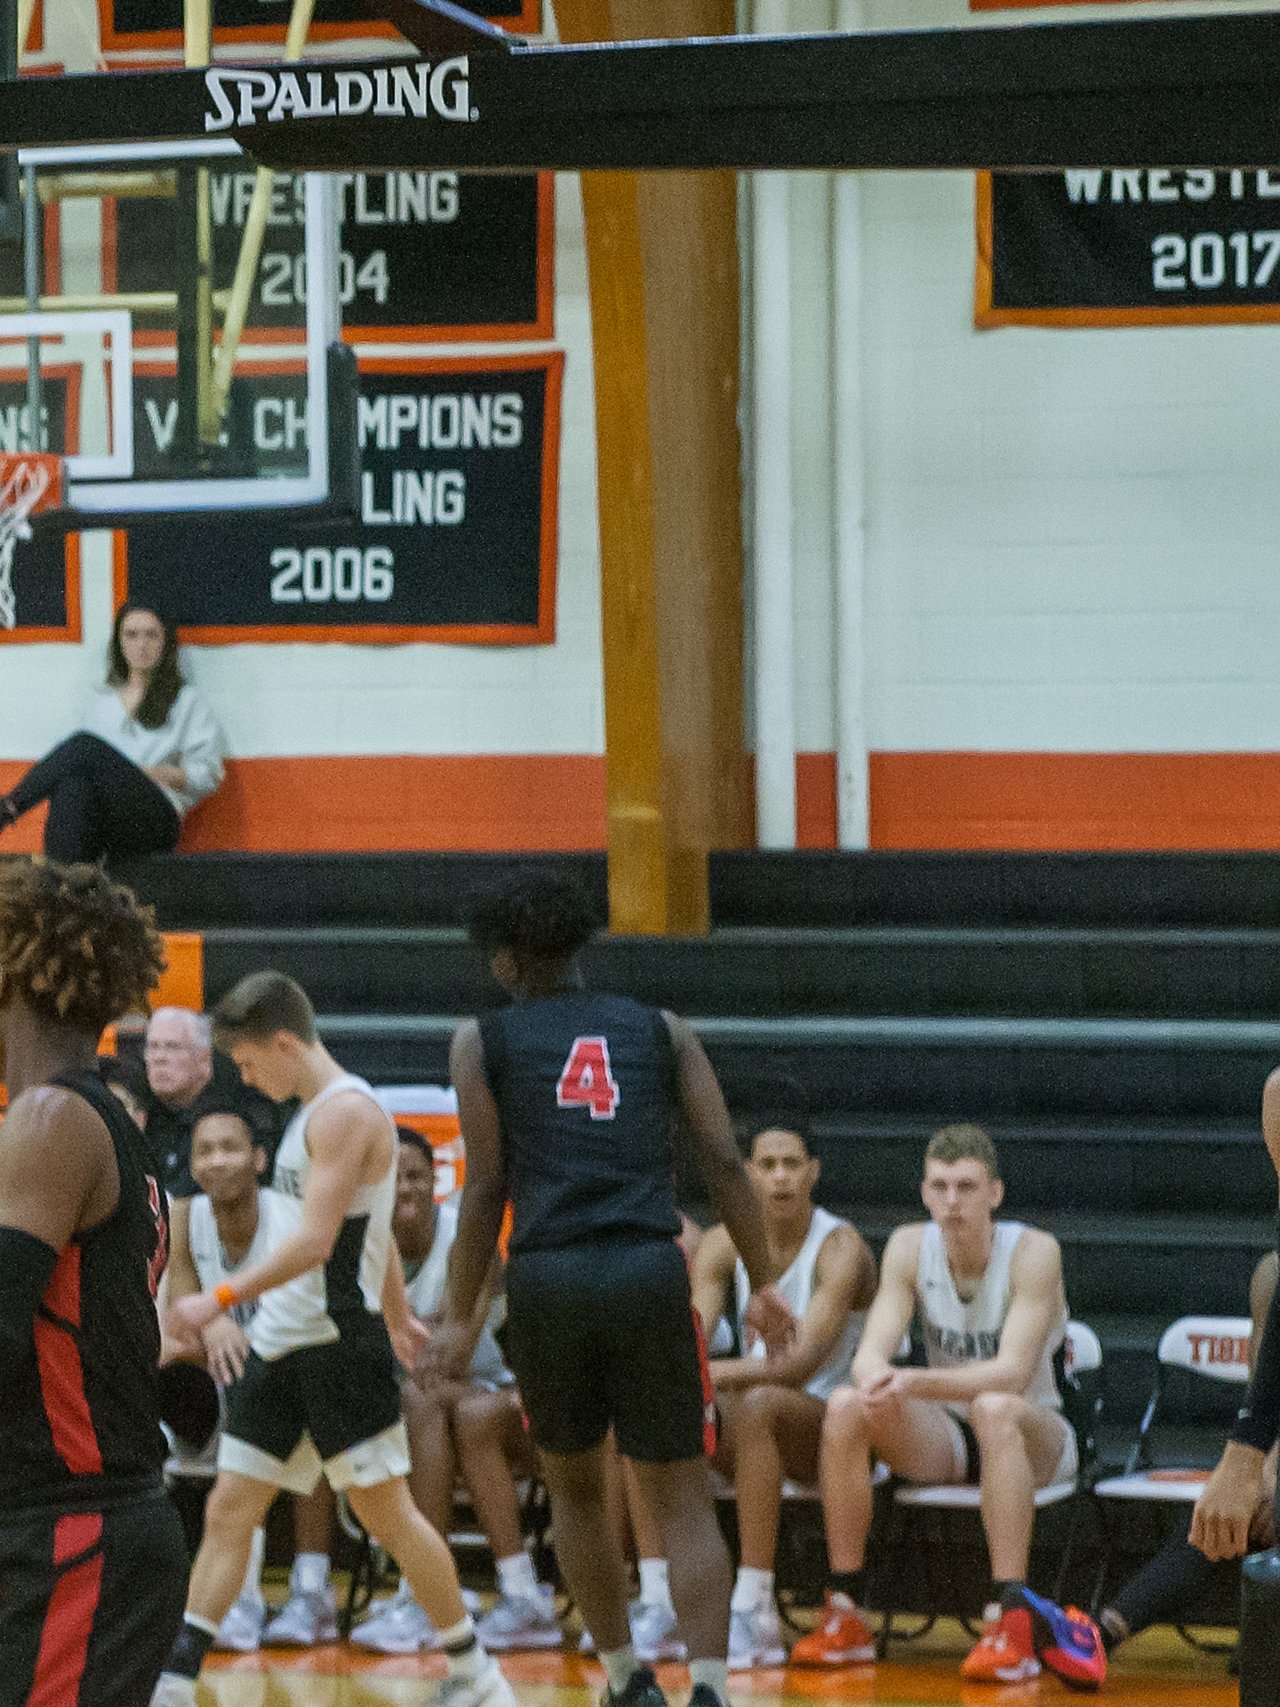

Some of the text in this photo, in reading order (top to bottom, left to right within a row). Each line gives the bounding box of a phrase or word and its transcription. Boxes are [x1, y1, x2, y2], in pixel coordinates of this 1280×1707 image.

[204, 56, 470, 132] SPALDING
[1151, 232, 1280, 291] 2017
[253, 392, 523, 450] CHMPIONS
[270, 547, 394, 602] 2006
[556, 1035, 620, 1121] 4
